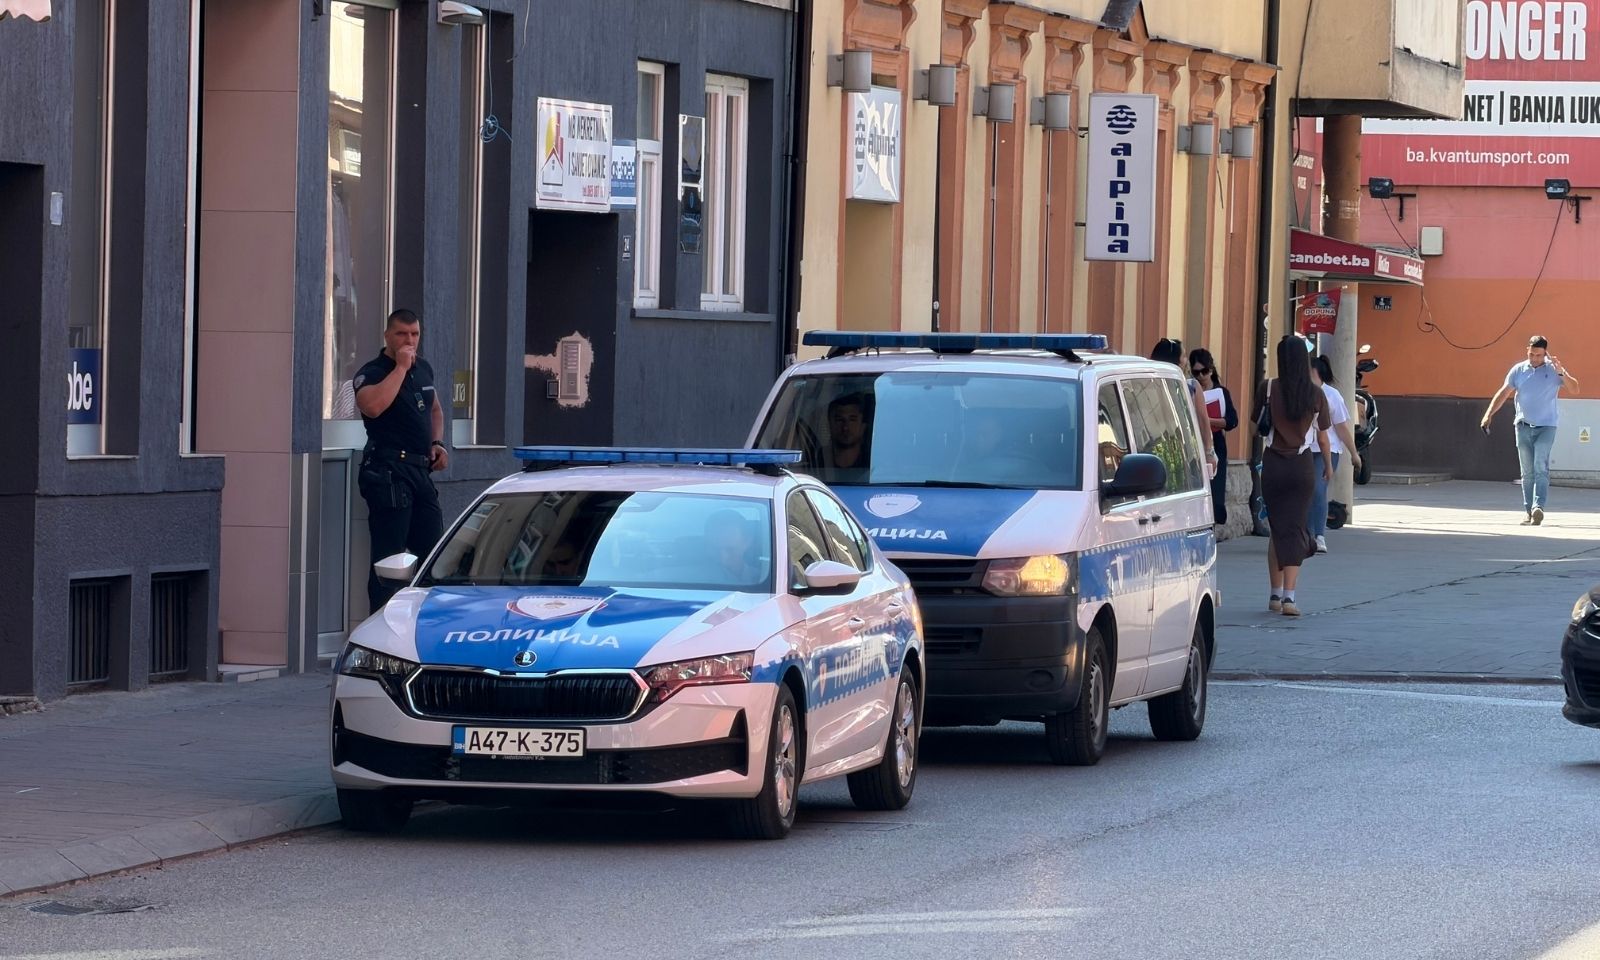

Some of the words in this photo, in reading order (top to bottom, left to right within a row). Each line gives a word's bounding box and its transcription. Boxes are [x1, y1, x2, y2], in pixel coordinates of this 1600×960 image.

[1466, 1, 1587, 61] ONGER
[1464, 94, 1494, 122] NET
[1509, 95, 1566, 123] BANJA
[1569, 96, 1600, 124] LUK
[868, 126, 896, 162] alpina
[1406, 147, 1570, 167] ba.kvantumsport.com
[1107, 142, 1132, 253] alpina
[1304, 308, 1336, 317] DOPUNA
[444, 629, 620, 649] ПОЛИЦИЈА
[468, 730, 580, 753] A47-K-375
